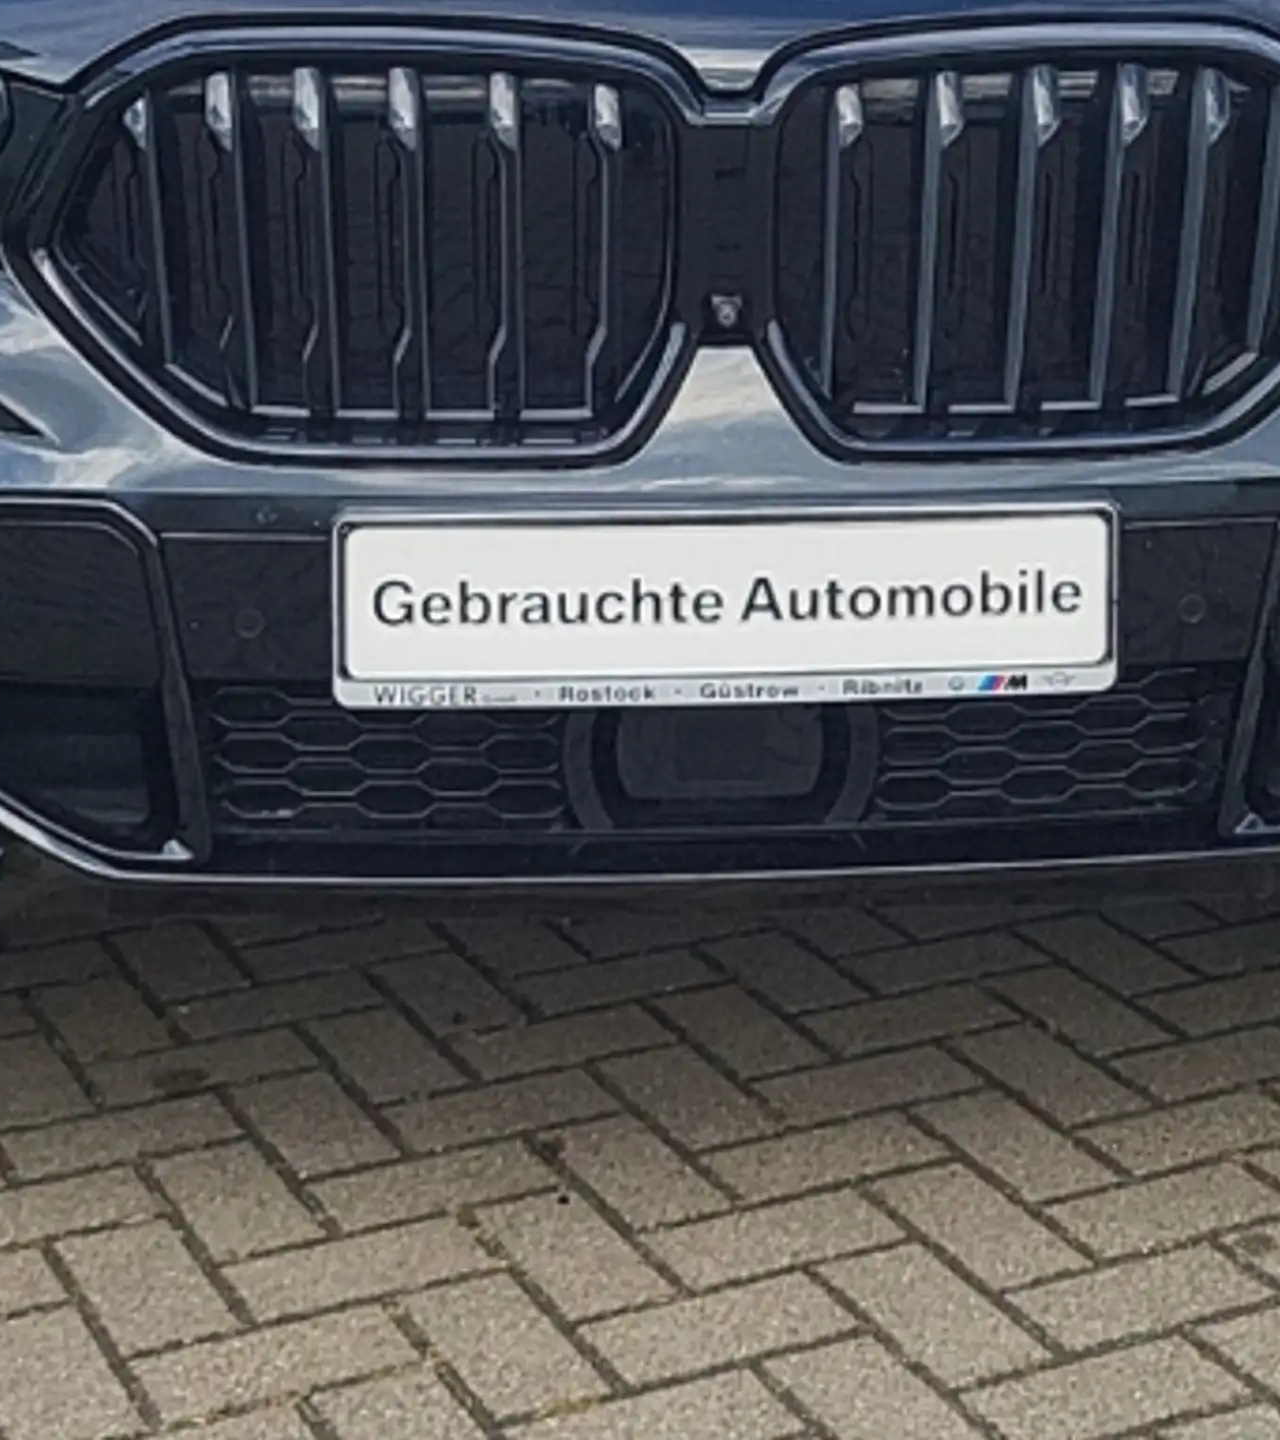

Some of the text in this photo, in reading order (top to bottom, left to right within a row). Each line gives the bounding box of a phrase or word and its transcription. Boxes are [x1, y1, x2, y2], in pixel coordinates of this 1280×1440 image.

[372, 569, 1083, 627] Gebrauchte Automobile
[373, 684, 477, 706] WIGGER
[557, 683, 656, 703] Rostock
[699, 680, 800, 700] Güstrow
